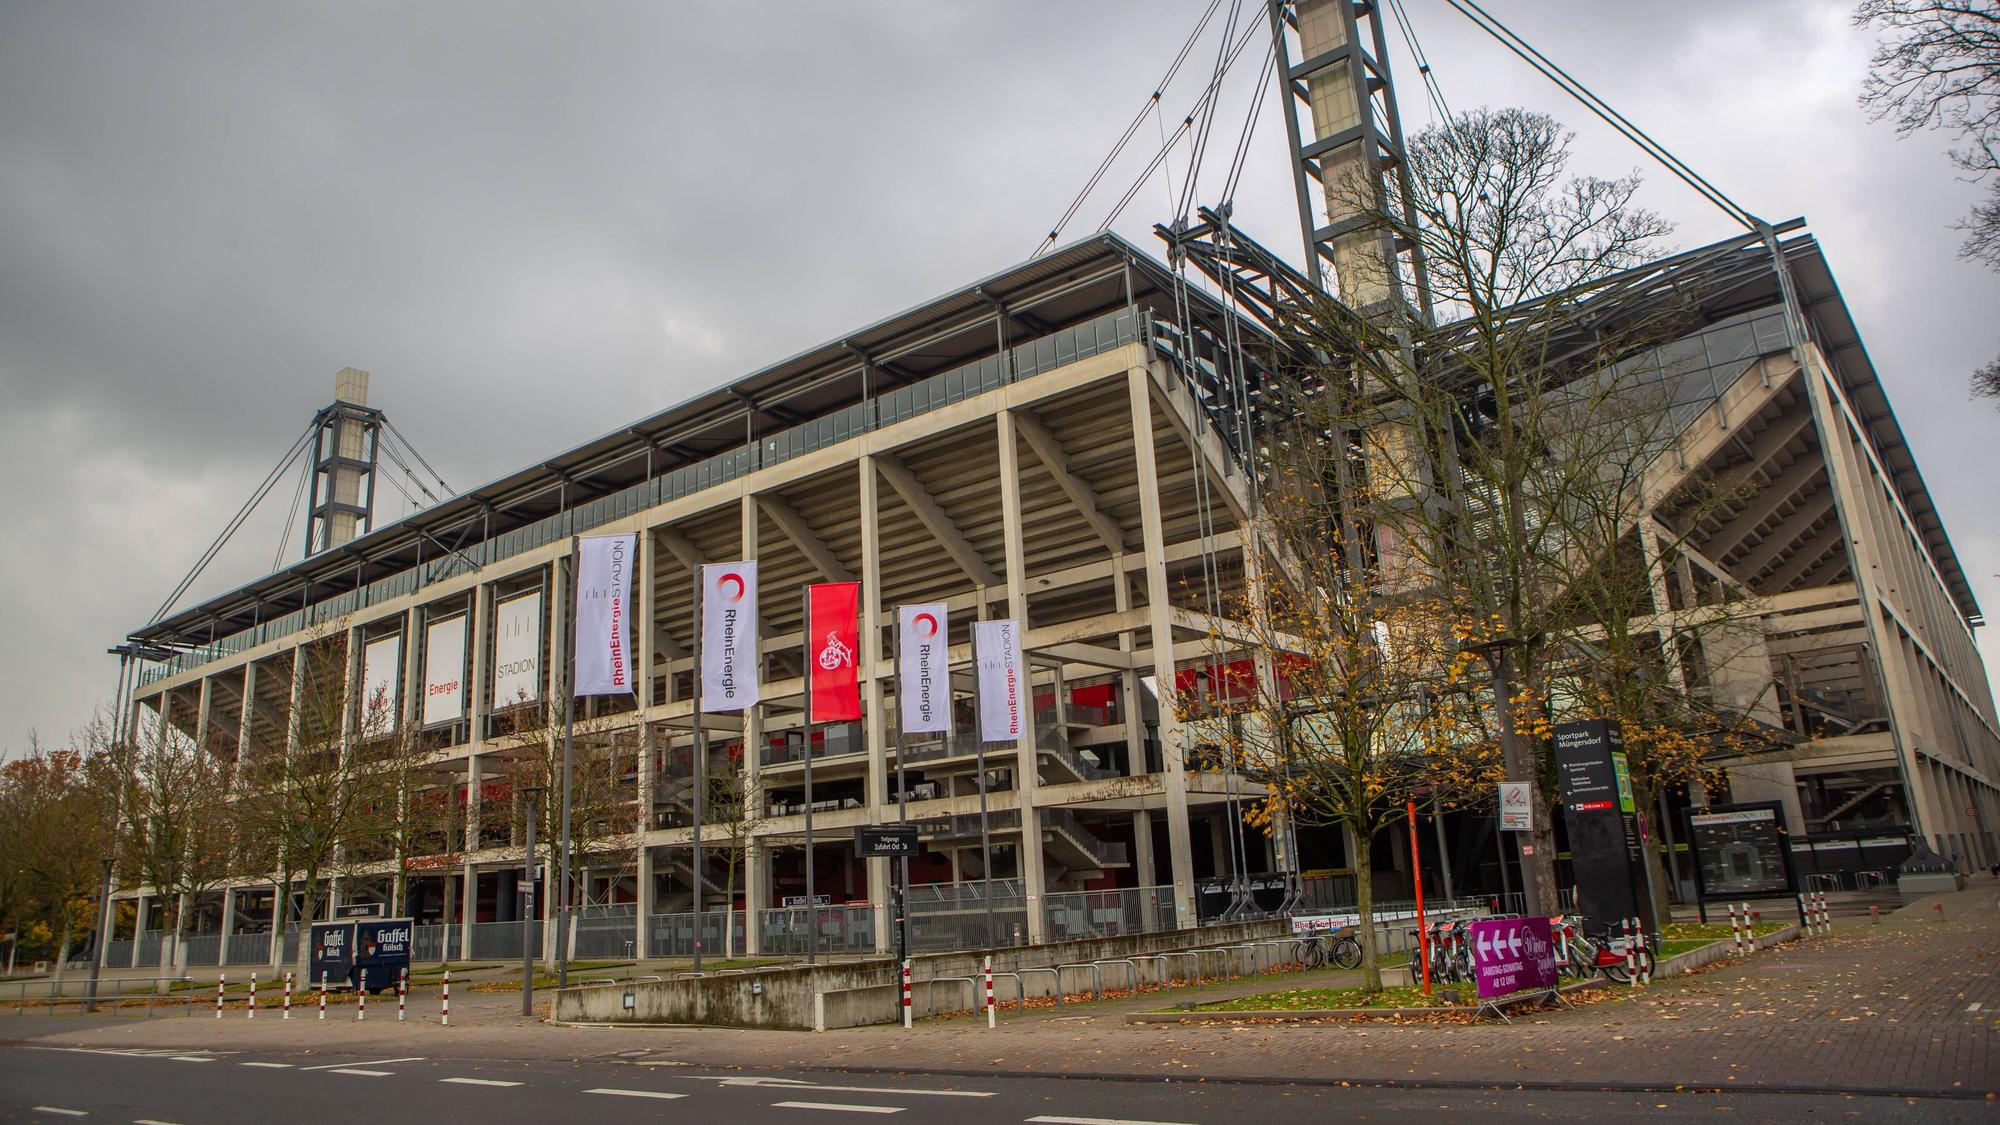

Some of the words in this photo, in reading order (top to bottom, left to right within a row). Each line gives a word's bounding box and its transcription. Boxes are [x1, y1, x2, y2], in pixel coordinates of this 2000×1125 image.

[722, 609, 736, 699] RheinEnergie
[498, 657, 536, 680] STADION
[429, 678, 459, 697] Energie
[920, 644, 931, 722] RheinEnergie
[1557, 730, 1589, 742] Sportpark
[1558, 736, 1602, 749] Müngersdorf
[874, 843, 891, 851] Zufahrt
[324, 929, 345, 946] Gaffel
[377, 927, 410, 944] Gaffel
[326, 946, 340, 958] Kölsch
[382, 942, 404, 953] Kölsch
[1482, 961, 1524, 977] SAMSTAG-SONNTAG
[1493, 978, 1500, 988] AB
[1500, 977, 1506, 987] 12
[1506, 975, 1516, 986] UHR
